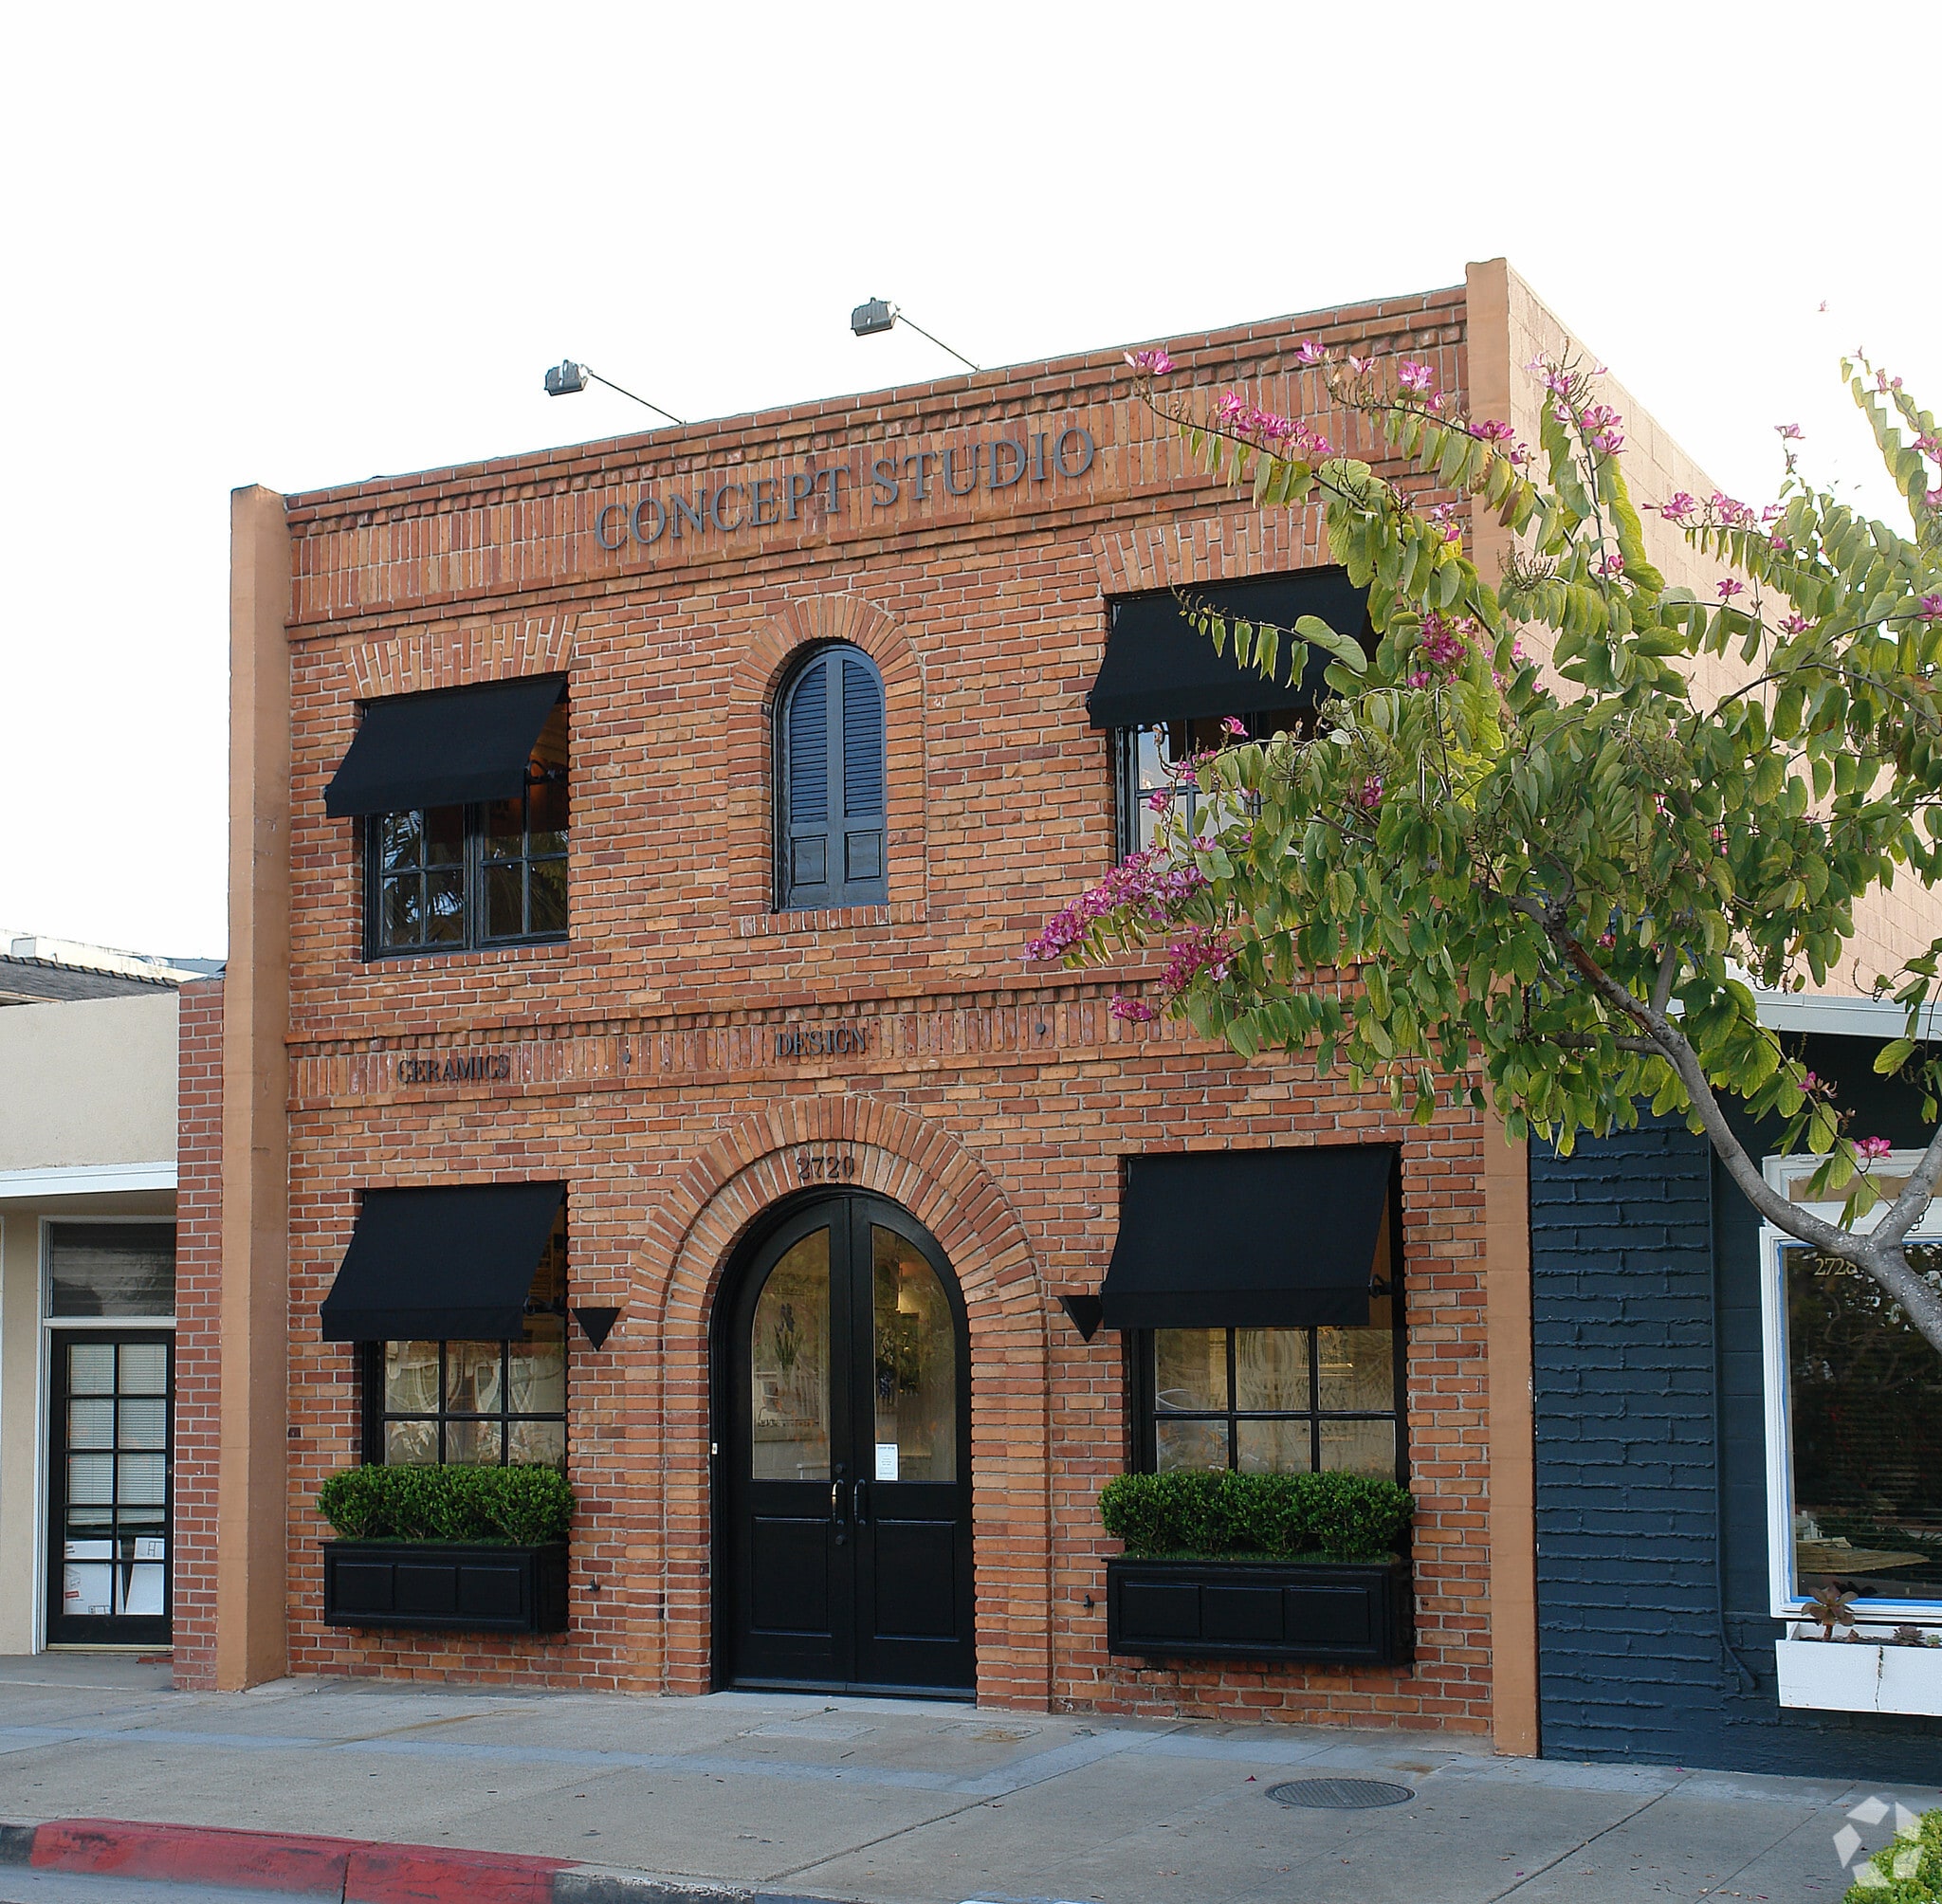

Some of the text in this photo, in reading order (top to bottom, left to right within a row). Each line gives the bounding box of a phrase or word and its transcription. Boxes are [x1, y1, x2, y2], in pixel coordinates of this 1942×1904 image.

[595, 427, 1094, 550] CONCEPT STUDIO
[776, 1027, 867, 1057] DESIGN
[397, 1054, 509, 1084] CERAMICS
[797, 1156, 854, 1180] 2720
